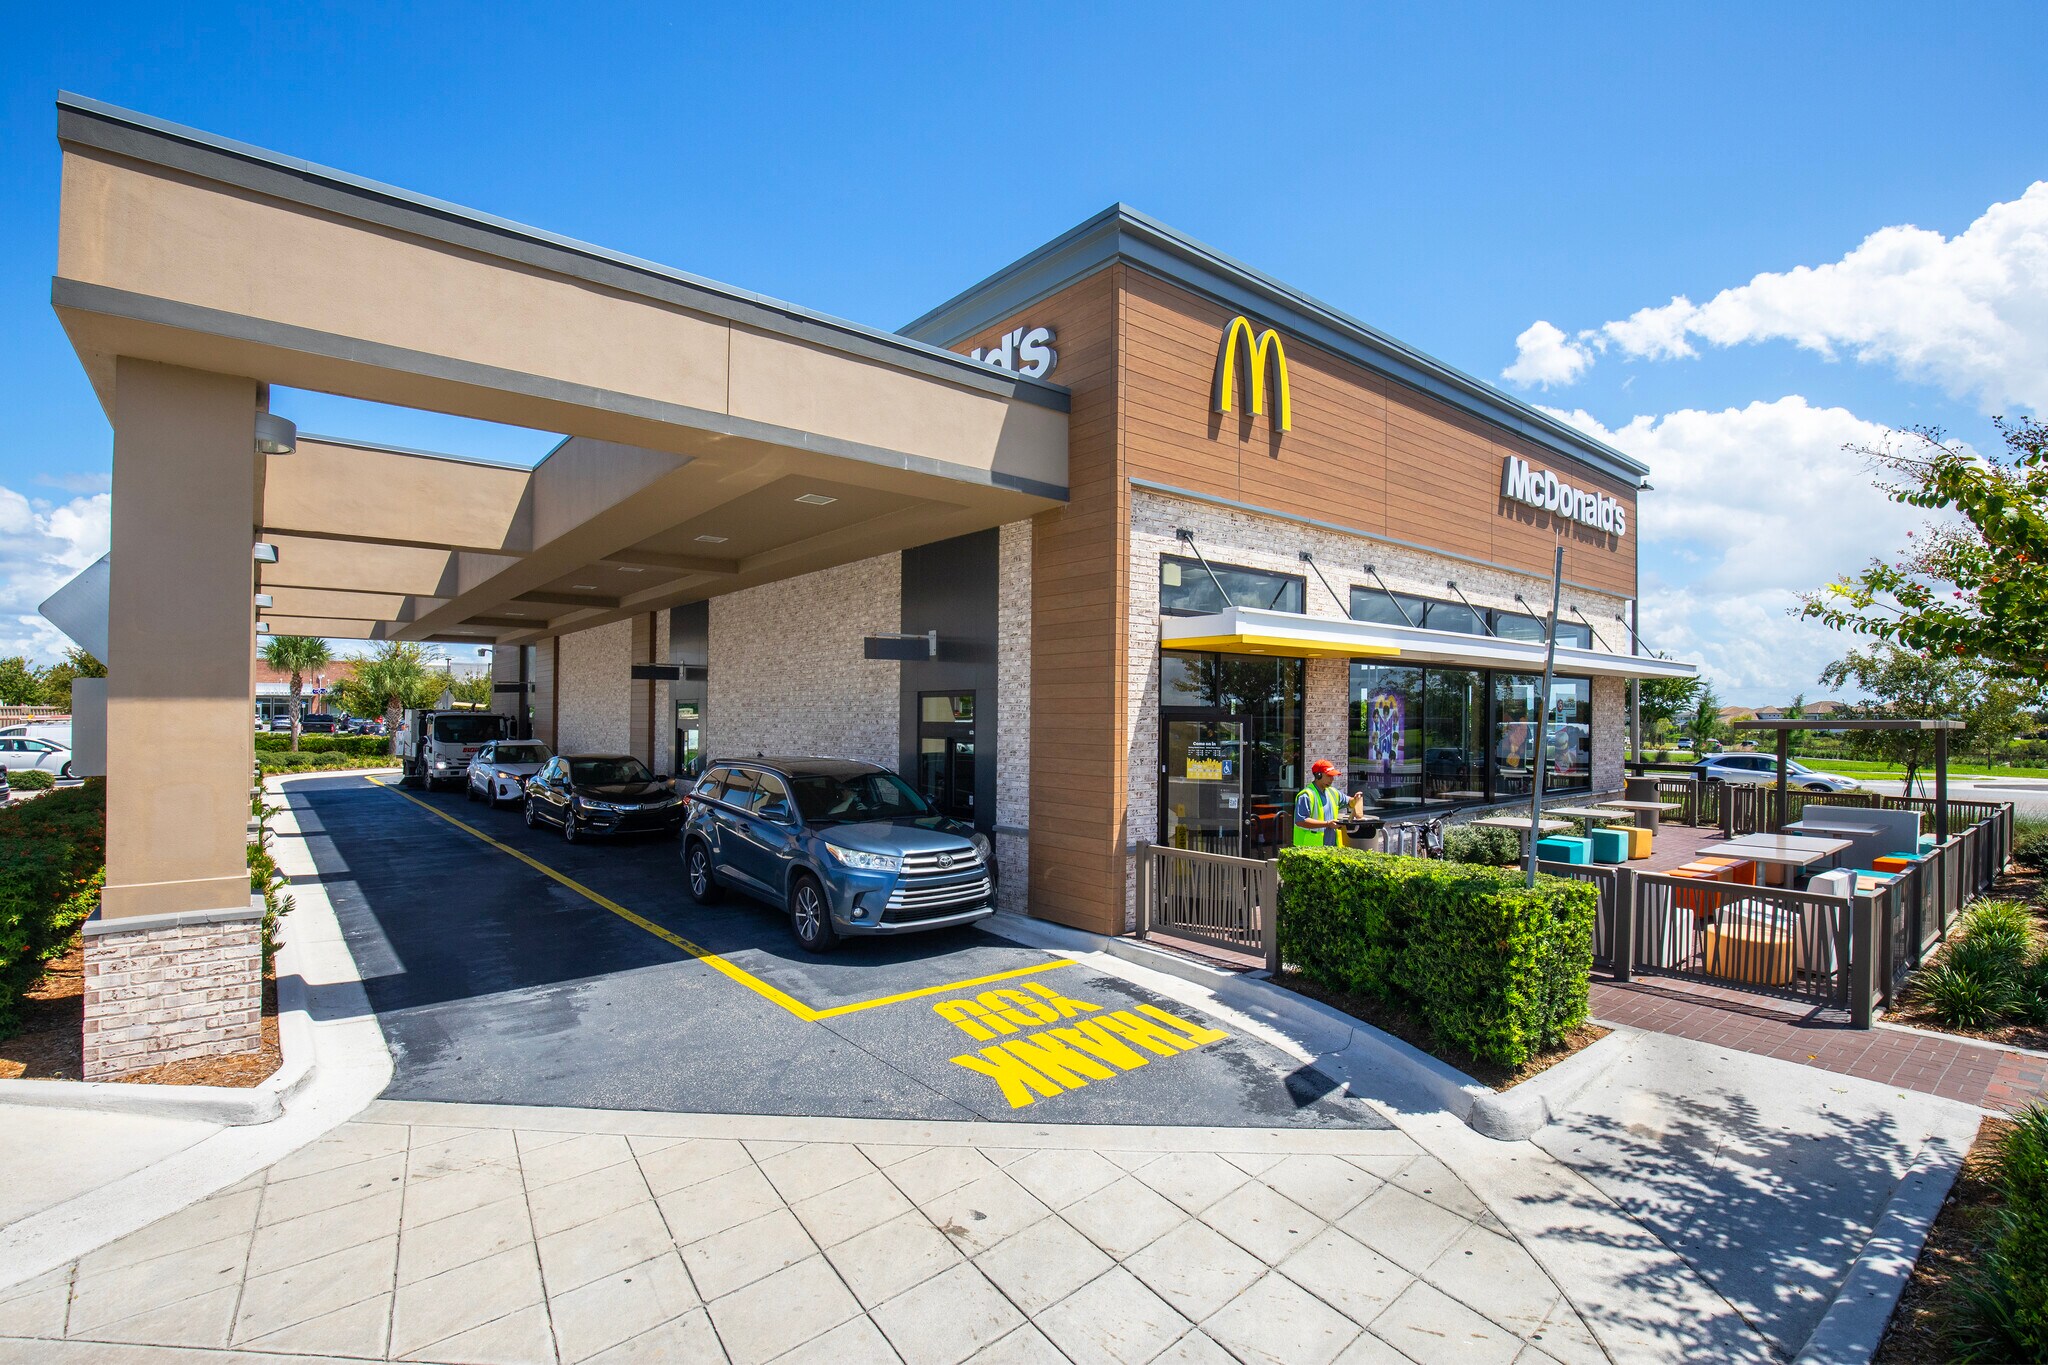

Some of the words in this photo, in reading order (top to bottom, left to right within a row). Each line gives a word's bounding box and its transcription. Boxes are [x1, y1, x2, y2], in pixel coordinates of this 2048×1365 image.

[1505, 455, 1626, 537] McDonald's
[932, 981, 1105, 1042] YOU
[948, 1003, 1231, 1110] THANK
